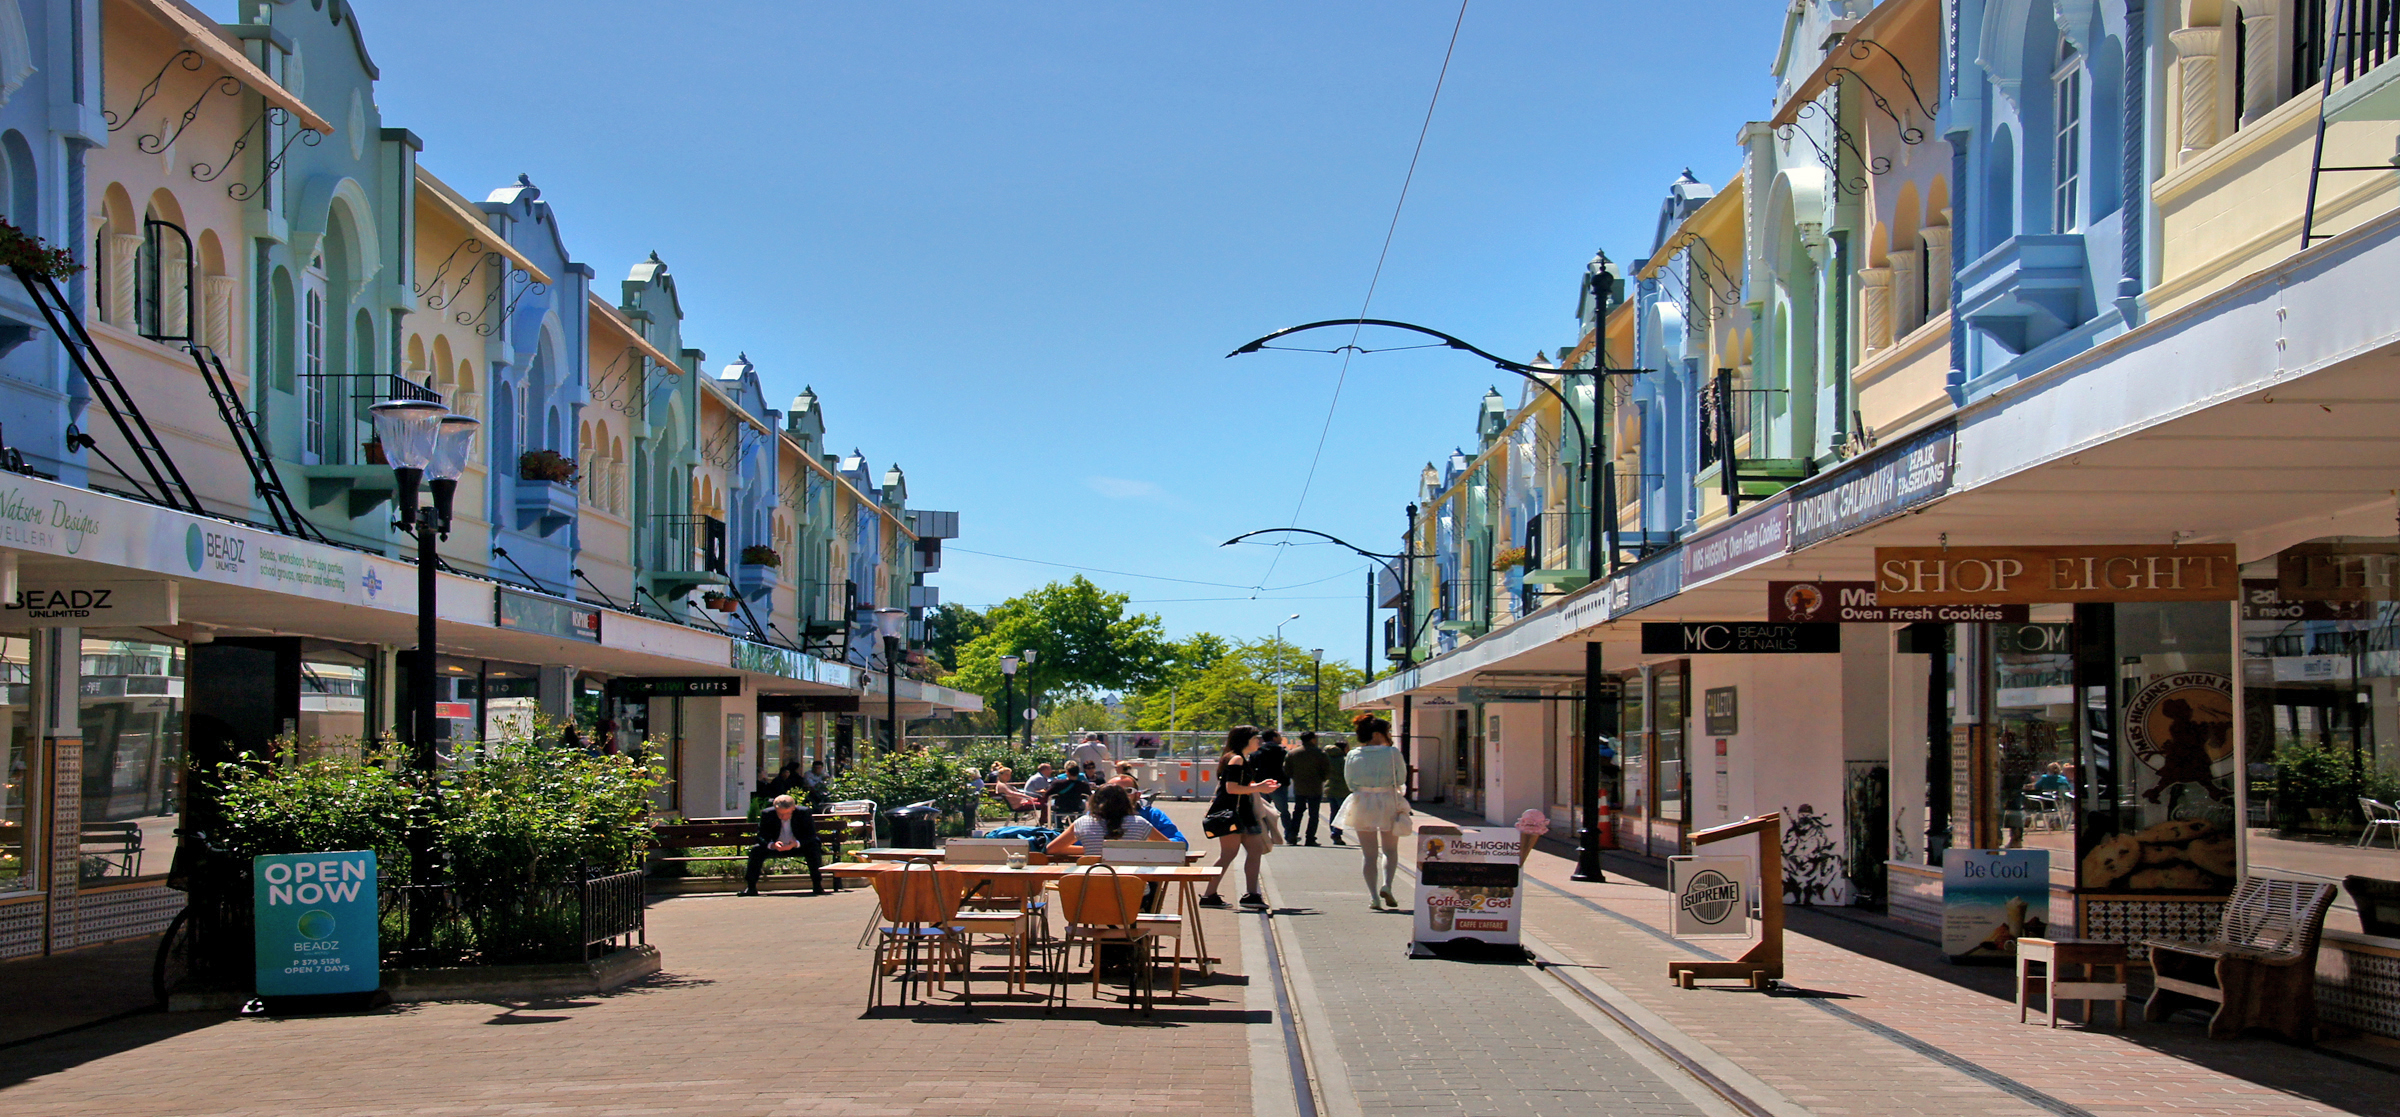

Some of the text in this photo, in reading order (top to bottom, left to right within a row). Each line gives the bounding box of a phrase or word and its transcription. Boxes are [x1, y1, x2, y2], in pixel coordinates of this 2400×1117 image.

[1909, 444, 1934, 470] HAIR
[0, 525, 54, 548] ELLERY
[51, 499, 100, 555] Designs
[206, 532, 246, 563] BEADZ
[1692, 516, 1782, 573] MRS HIGGINS Oven Fresh Cookies
[215, 562, 238, 573] UNLIMITED
[260, 563, 277, 577] school
[313, 573, 322, 586] and
[1880, 556, 2229, 594] SHOP EIGHT
[5, 589, 113, 610] BEADZ
[1840, 588, 1877, 607] MR
[29, 609, 90, 618] UNLIMITED
[1840, 607, 2003, 621] Oven Fresh Cookies
[1684, 625, 1731, 651] MC
[1738, 626, 1797, 638] BEAUTY
[1738, 638, 1797, 650] & NAILS
[689, 682, 728, 691] GIFTS
[2172, 674, 2217, 687] OVEN
[2129, 681, 2170, 724] HIGGINS
[2129, 726, 2152, 750] MRS
[1475, 841, 1520, 851] HIGGINS
[264, 859, 366, 884] OPEN
[1964, 860, 2028, 878] Be Cool
[269, 881, 361, 906] NOW
[1426, 894, 1511, 910] Coffee 2 Go!
[1684, 884, 1736, 907] SUPREME
[1459, 920, 1476, 928] CAFFE
[294, 941, 339, 952] BEADZ
[284, 966, 313, 974] OPEN
